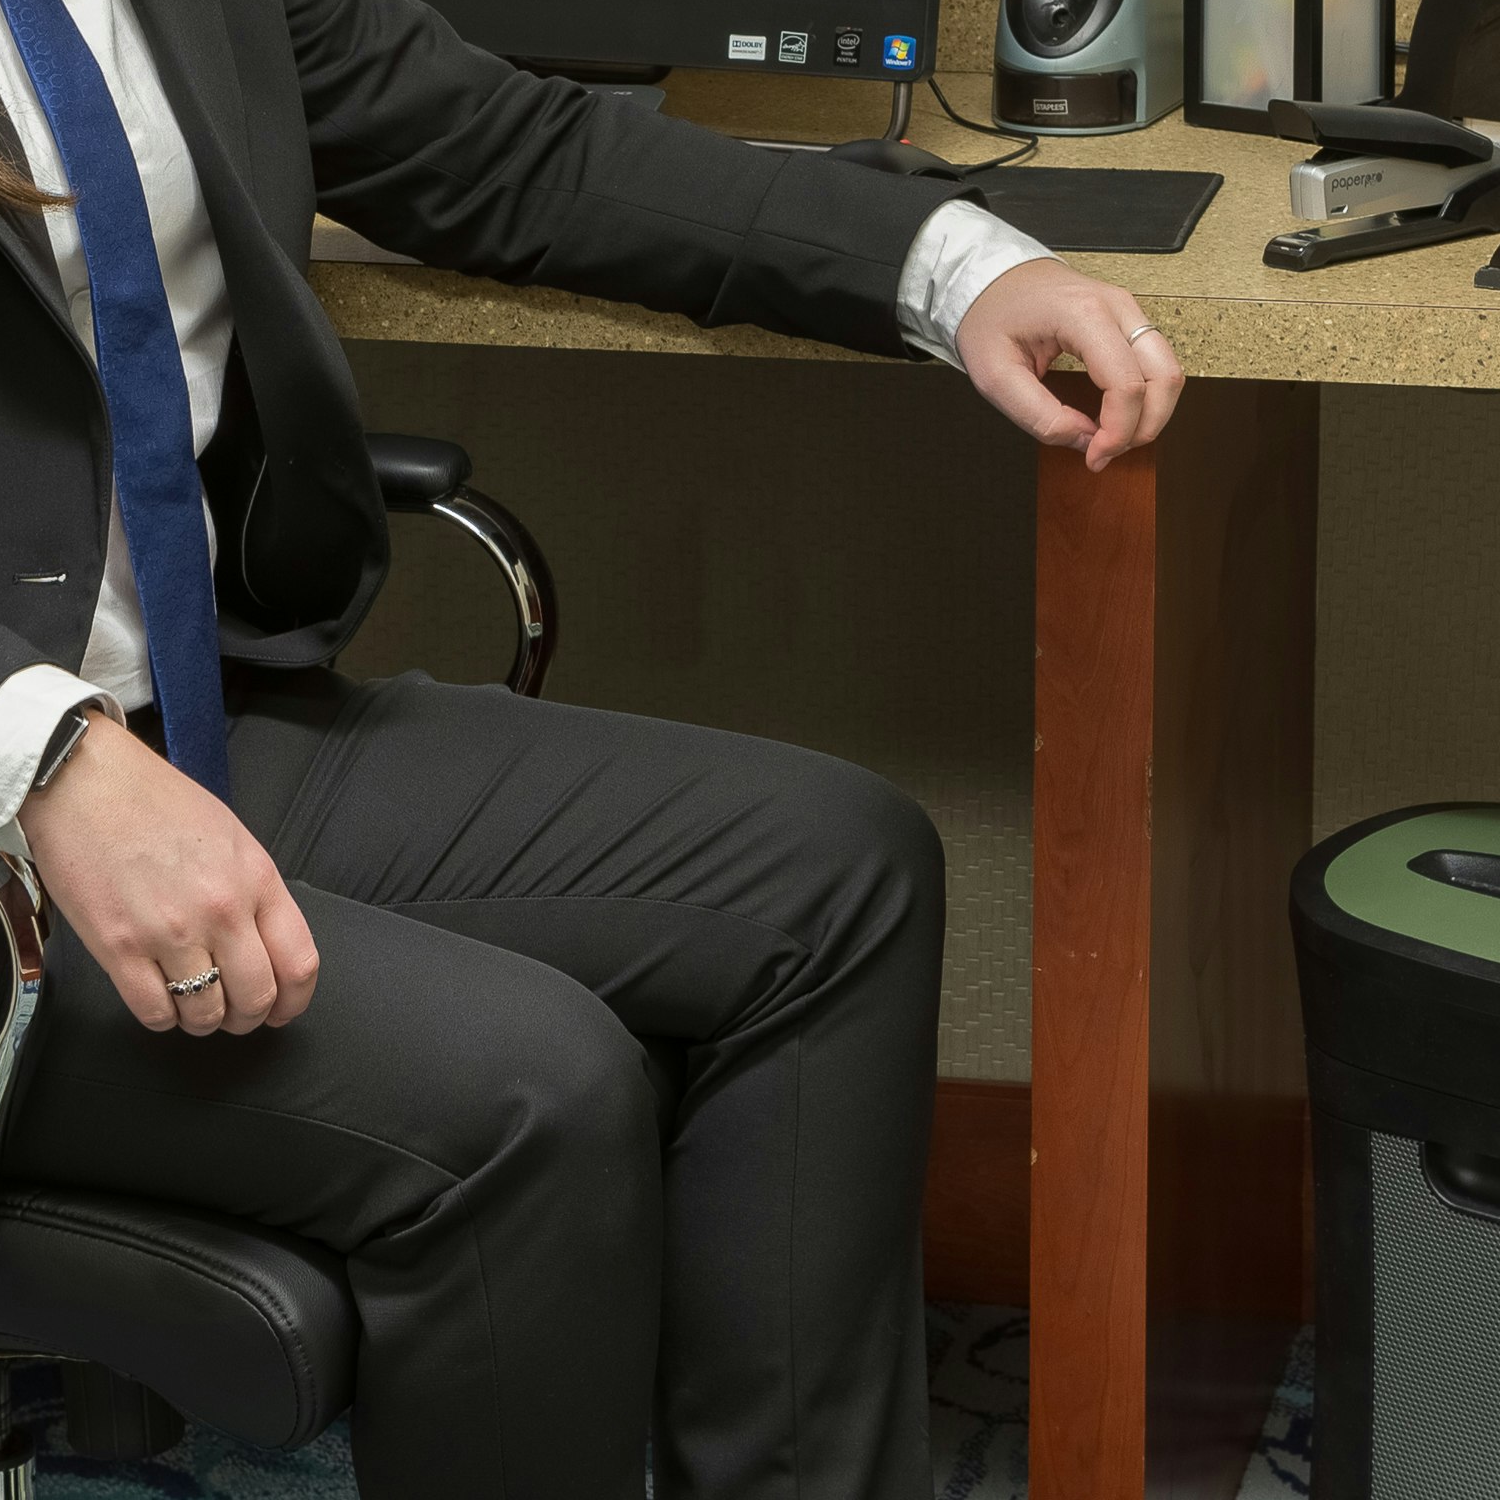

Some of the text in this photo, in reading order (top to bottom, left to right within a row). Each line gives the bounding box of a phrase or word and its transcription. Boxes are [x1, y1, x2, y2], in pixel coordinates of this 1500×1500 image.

[741, 40, 763, 49] DOLBY
[840, 37, 857, 46] intel
[1035, 102, 1066, 111] STAPLES
[1331, 171, 1383, 193] paperpro
